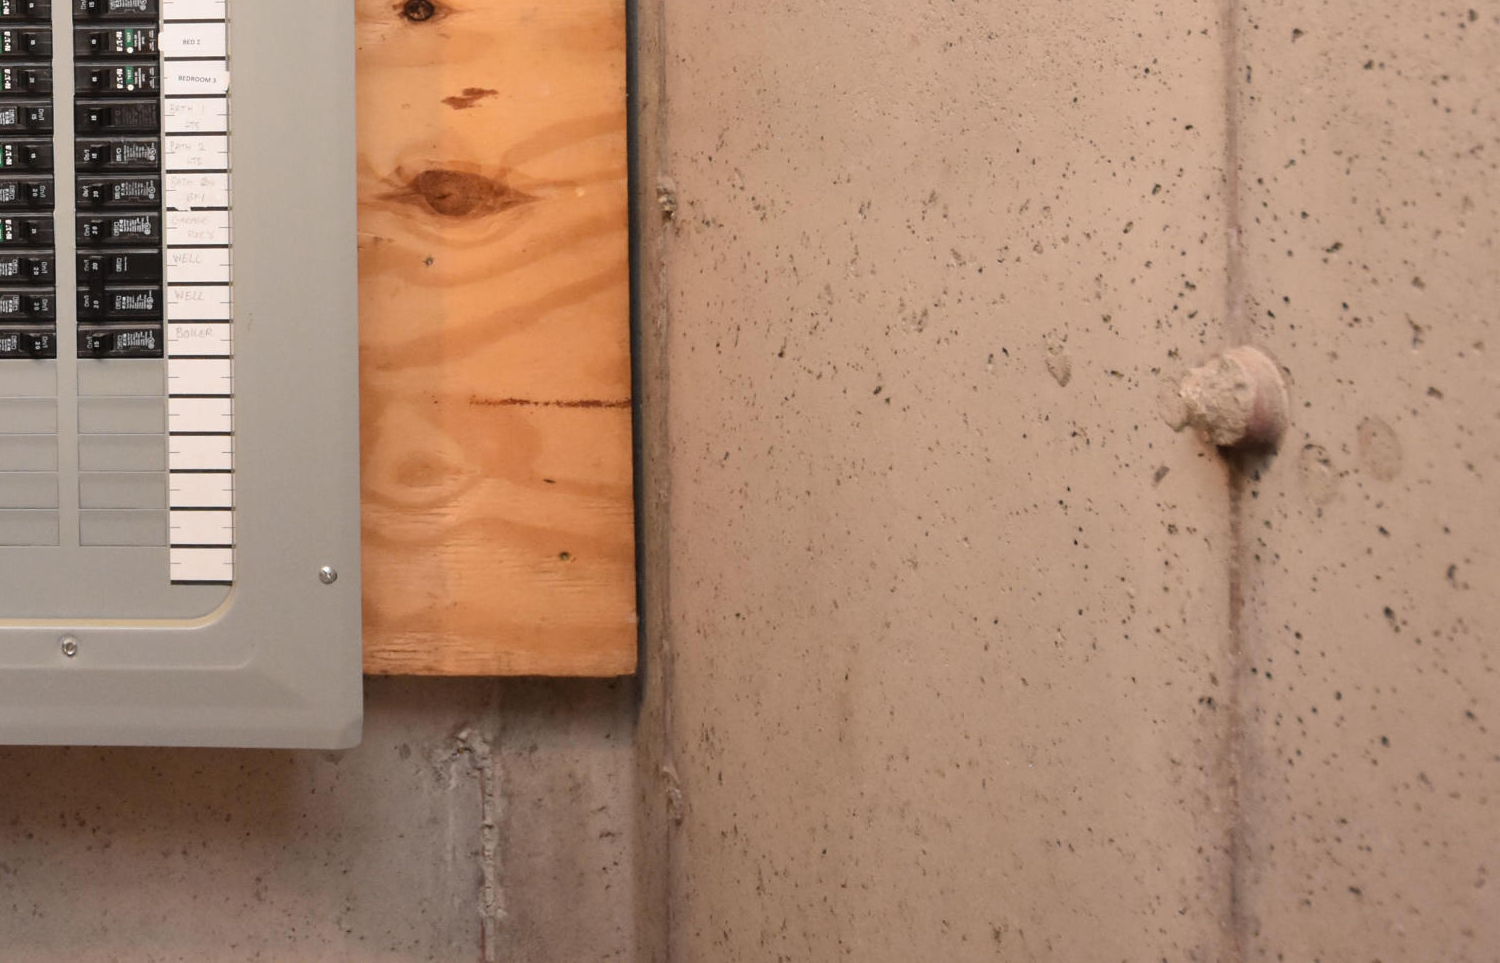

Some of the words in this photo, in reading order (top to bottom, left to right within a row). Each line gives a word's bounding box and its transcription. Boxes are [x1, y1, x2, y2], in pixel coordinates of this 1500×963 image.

[178, 75, 211, 84] BEDROOM
[32, 188, 38, 197] 20
[91, 226, 98, 235] 20
[173, 253, 202, 264] WELL
[33, 266, 40, 276] 20
[174, 289, 205, 301] WELL
[34, 302, 40, 311] 20
[93, 300, 99, 309] 20
[175, 327, 213, 339] BOILER
[35, 341, 41, 350] 20
